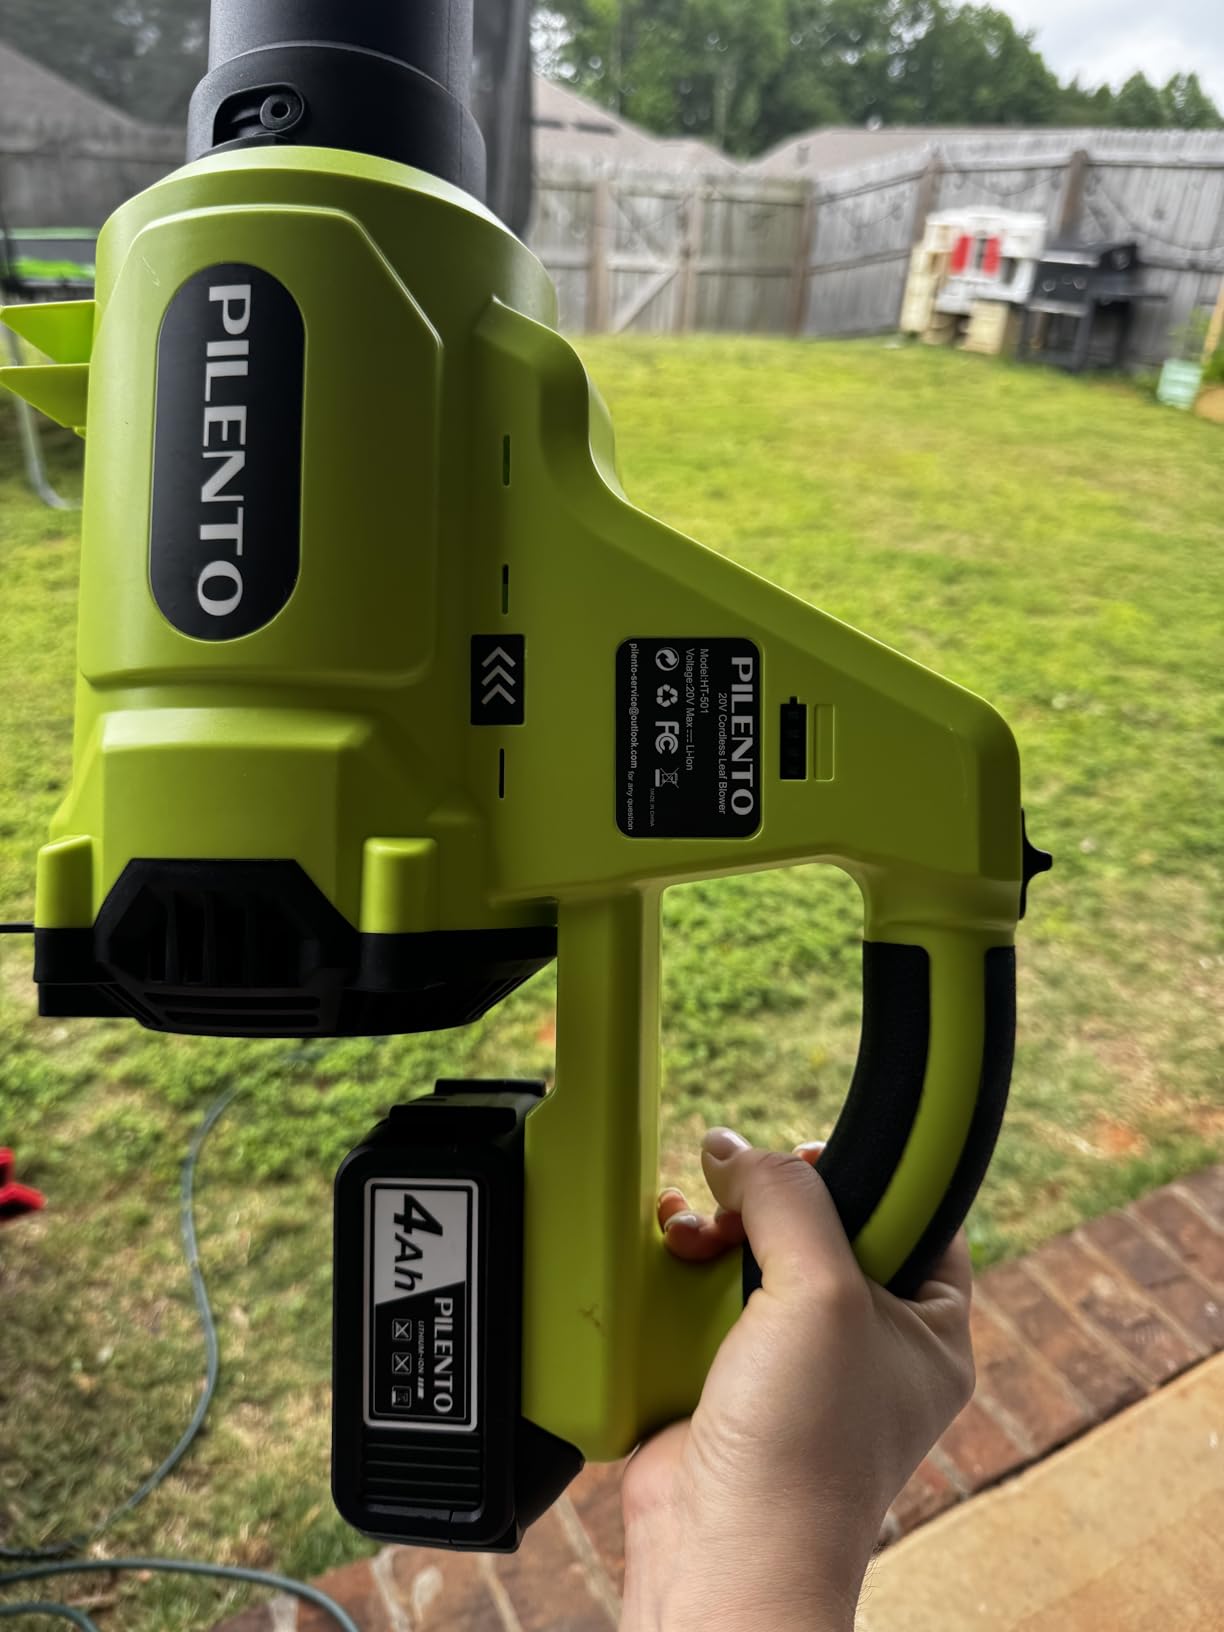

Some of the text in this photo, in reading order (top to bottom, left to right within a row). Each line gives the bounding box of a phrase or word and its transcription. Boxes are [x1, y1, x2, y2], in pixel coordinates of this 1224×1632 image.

[196, 283, 252, 617] PILENTO
[629, 643, 638, 768] pilento-service@outlook.com
[684, 648, 694, 770] Voltage:20V Max Li-Ion
[700, 648, 709, 713] Model:HT-501
[731, 657, 754, 816] PILENTO
[718, 693, 727, 814] 20V Cordless Leaf Blower
[433, 1297, 453, 1412] PILENTO
